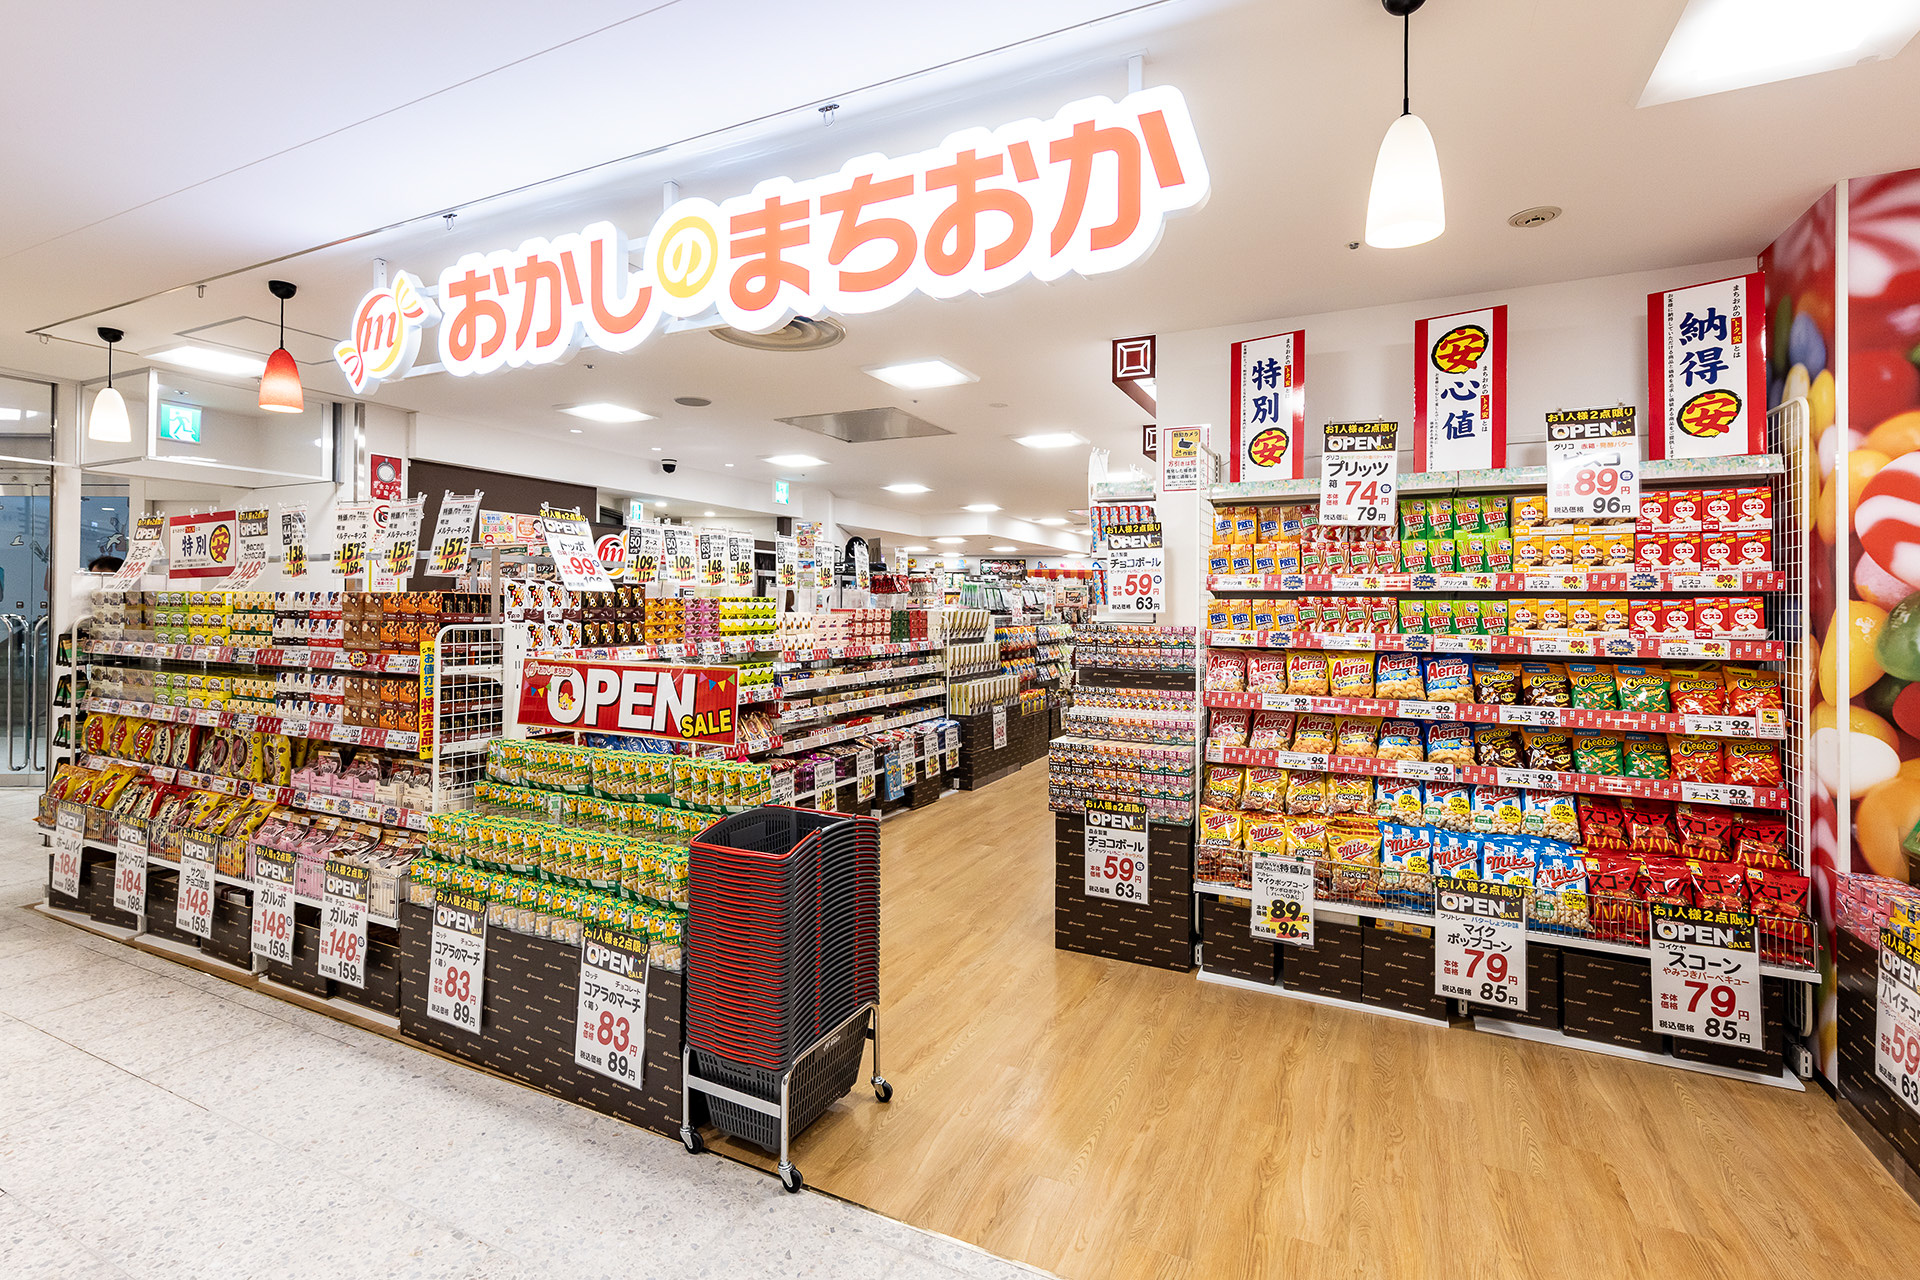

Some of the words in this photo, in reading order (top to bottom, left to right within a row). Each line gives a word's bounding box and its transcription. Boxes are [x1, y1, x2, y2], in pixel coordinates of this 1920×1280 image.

[447, 108, 1186, 361] おかしのまちおか
[1437, 329, 1486, 373] 安
[1679, 307, 1730, 388] 納得
[1251, 357, 1282, 424] 特別
[1440, 380, 1480, 441] 心値
[1684, 393, 1738, 437] 安
[1552, 422, 1618, 439] OPEN
[1612, 428, 1631, 437] SALE
[1252, 430, 1288, 466] 安
[1328, 436, 1382, 451] OPEN
[1376, 443, 1393, 451] SALE
[1328, 460, 1389, 477] プリッツ
[1329, 480, 1337, 488] 箱
[1744, 503, 1764, 511] ビスコ
[545, 520, 580, 535] OPEN
[1403, 515, 1424, 525] PRETZ
[240, 523, 263, 536] OPEN
[182, 534, 206, 557] 特別
[211, 527, 229, 560] 安
[560, 540, 586, 551] トッポ
[1110, 534, 1152, 549] OPEN
[1110, 557, 1161, 569] チョコボール
[1279, 558, 1296, 568] PRETZ
[1461, 555, 1482, 565] PRETZ
[1332, 662, 1370, 679] Aerial
[1481, 672, 1514, 686] Cheetos
[547, 667, 697, 733] OPEN
[681, 709, 733, 738] SALE
[421, 696, 434, 746] 特売品
[1429, 726, 1469, 743] Aerial
[1680, 740, 1718, 756] Cheetos
[1089, 813, 1134, 829] OPEN
[1682, 818, 1730, 837] スコーン
[120, 828, 142, 844] OPEN
[1088, 836, 1145, 852] チョコボール
[184, 843, 209, 860] OPEN
[1385, 837, 1431, 856] Mike
[258, 861, 287, 881] OPEN
[327, 878, 359, 898] OPEN
[1258, 877, 1309, 890] マイクポップコーン
[1438, 878, 1522, 898] お1人様2点限り
[1753, 883, 1807, 902] スコーン
[260, 889, 287, 908] ガルボ
[1441, 895, 1506, 916] OPEN
[1499, 911, 1519, 919] SALE
[330, 907, 359, 927] ガルボ
[437, 908, 476, 933] OPEN
[1440, 913, 1466, 921] フリトレー
[1653, 904, 1755, 926] お1人様2点限り
[1463, 924, 1496, 937] マイク
[1656, 923, 1734, 946] OPEN
[1727, 941, 1751, 949] SALE
[1447, 933, 1512, 952] ポップコーン
[1659, 942, 1687, 951] コイケヤ
[435, 942, 480, 966] コアラのマーチ
[586, 946, 634, 977] OPEN
[628, 970, 643, 979] SALE
[1669, 951, 1742, 975] スコーン
[585, 970, 598, 980] ロッテ
[615, 981, 641, 995] チョコレート
[1663, 967, 1749, 986] やみつきバーベキュー
[584, 981, 641, 1014] コアラのマーチ
[1442, 984, 1472, 996] 税込価格
[1660, 993, 1678, 1002] 本体
[1660, 1001, 1678, 1010] 価格
[1659, 1020, 1695, 1033] 税込価格
